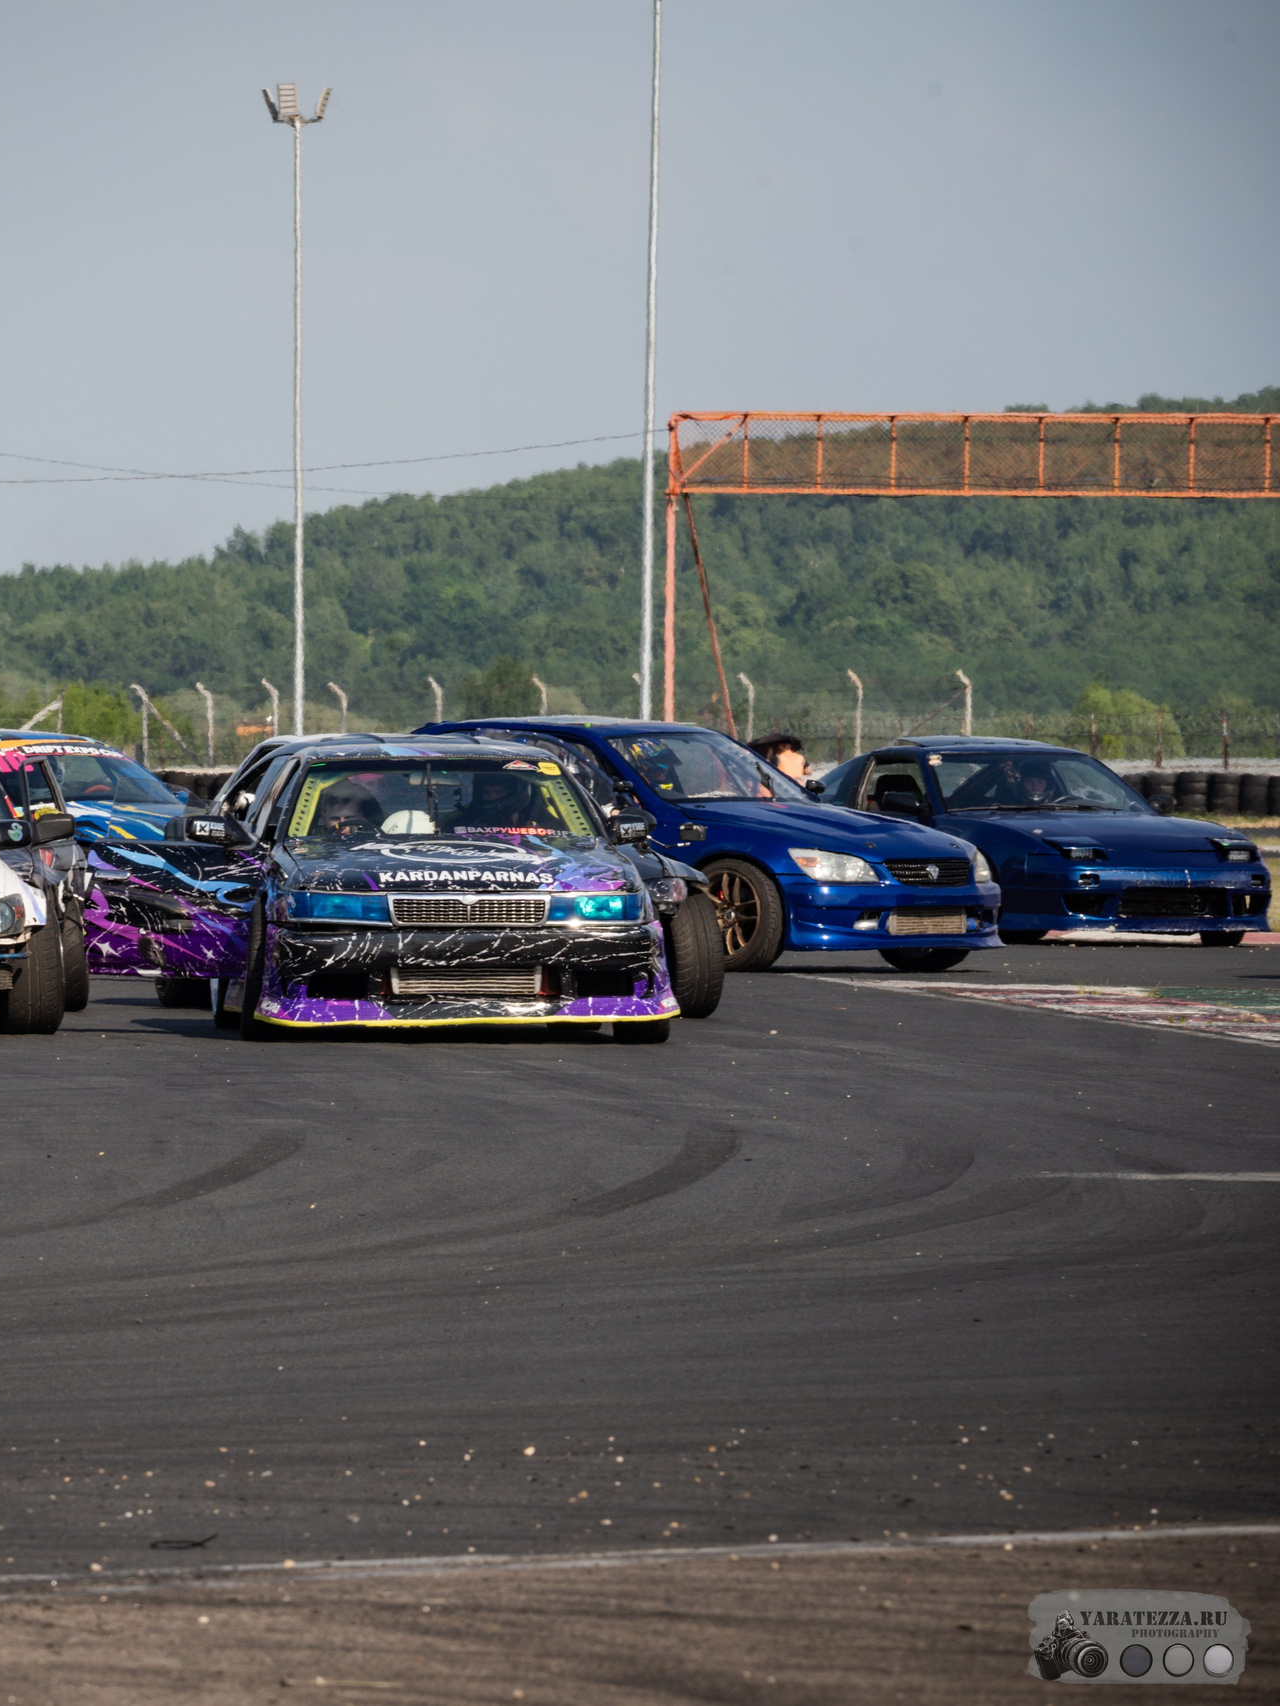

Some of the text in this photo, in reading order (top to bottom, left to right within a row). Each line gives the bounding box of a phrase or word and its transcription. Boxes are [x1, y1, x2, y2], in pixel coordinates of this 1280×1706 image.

[25, 745, 65, 754] DRIFT
[66, 746, 99, 755] EXPO
[379, 871, 554, 884] KARDANPARNAS
